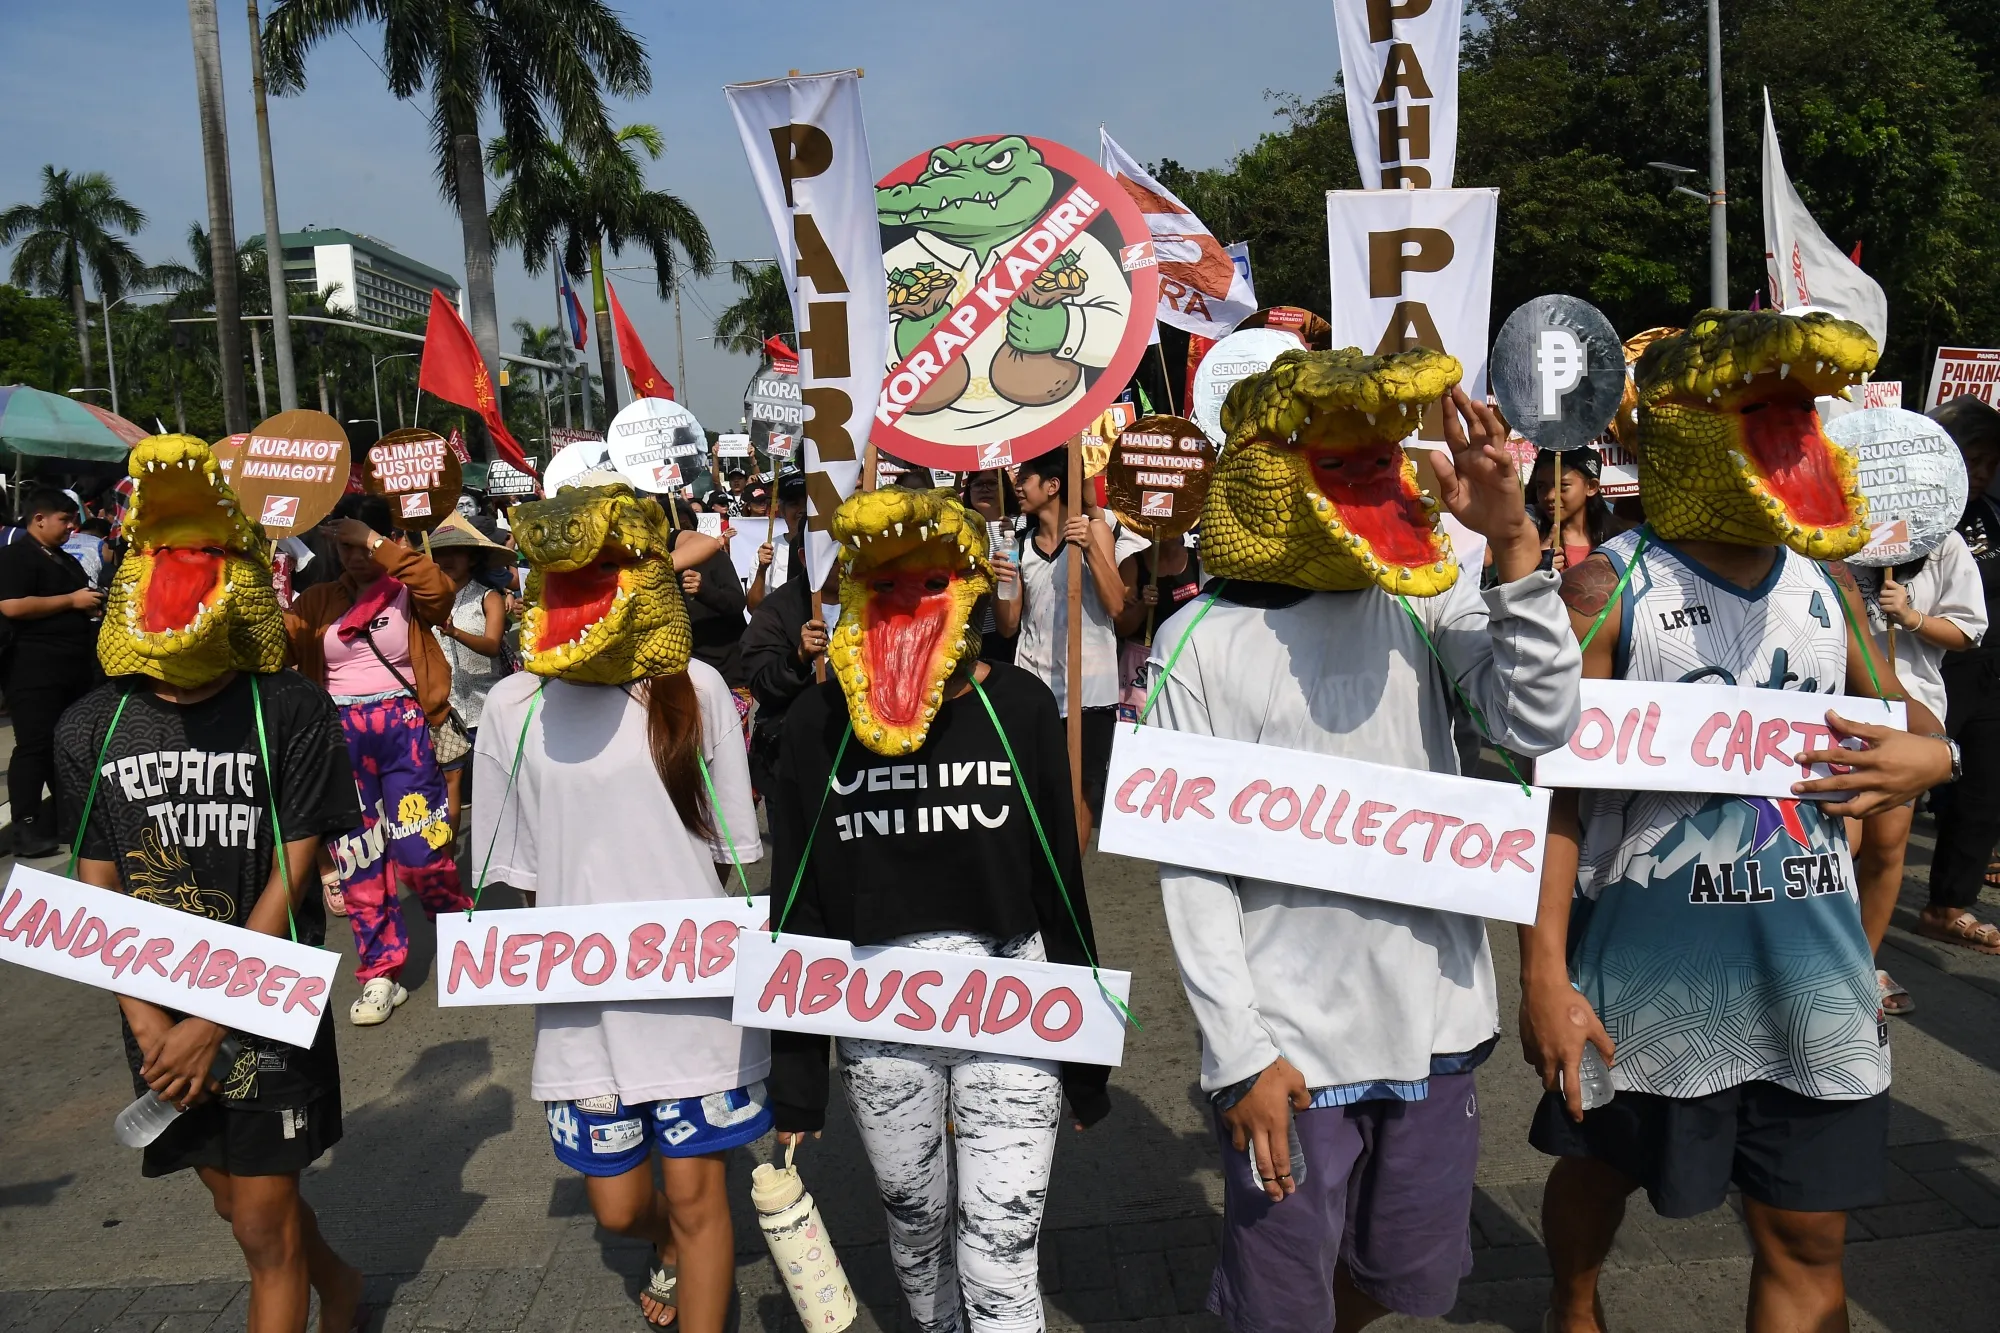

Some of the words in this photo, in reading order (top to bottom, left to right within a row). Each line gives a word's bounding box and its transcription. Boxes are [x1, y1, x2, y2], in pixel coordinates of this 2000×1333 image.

[1123, 258, 1156, 271] PAHRA
[876, 305, 977, 426] KORAP
[975, 187, 1100, 311] KADIRI!
[1213, 362, 1267, 375] SENIORS
[617, 415, 688, 436] WAKASAN
[249, 438, 341, 459] KURAKOT
[645, 433, 672, 446] ANG
[1122, 434, 1172, 448] HANDS
[1180, 437, 1206, 451] OFF
[370, 440, 445, 462] CLIMATE
[626, 443, 698, 466] KATIWALIAN
[768, 446, 790, 456] PAHRA
[1122, 454, 1144, 464] THE
[1146, 456, 1203, 469] NATION'S
[244, 461, 335, 481] MANAGOT!
[373, 456, 444, 477] JUSTICE
[980, 457, 1011, 468] PAHRA
[1137, 471, 1184, 486] FUNDS!
[262, 515, 291, 526] PAHRA
[403, 508, 430, 516] PAHRA
[1142, 508, 1170, 516] PAHRA
[1862, 543, 1907, 557] PAHRA
[1659, 605, 1712, 631] LRTB
[1808, 590, 1830, 628] 4
[1568, 702, 1666, 766] OIL
[1114, 767, 1216, 823] CAR
[1229, 778, 1536, 873] COLLECTOR
[1689, 860, 1774, 904] ALL
[0, 888, 326, 1016] LANDGRABBER
[447, 926, 617, 994] NEPO
[757, 949, 1084, 1042] ABUSADO
